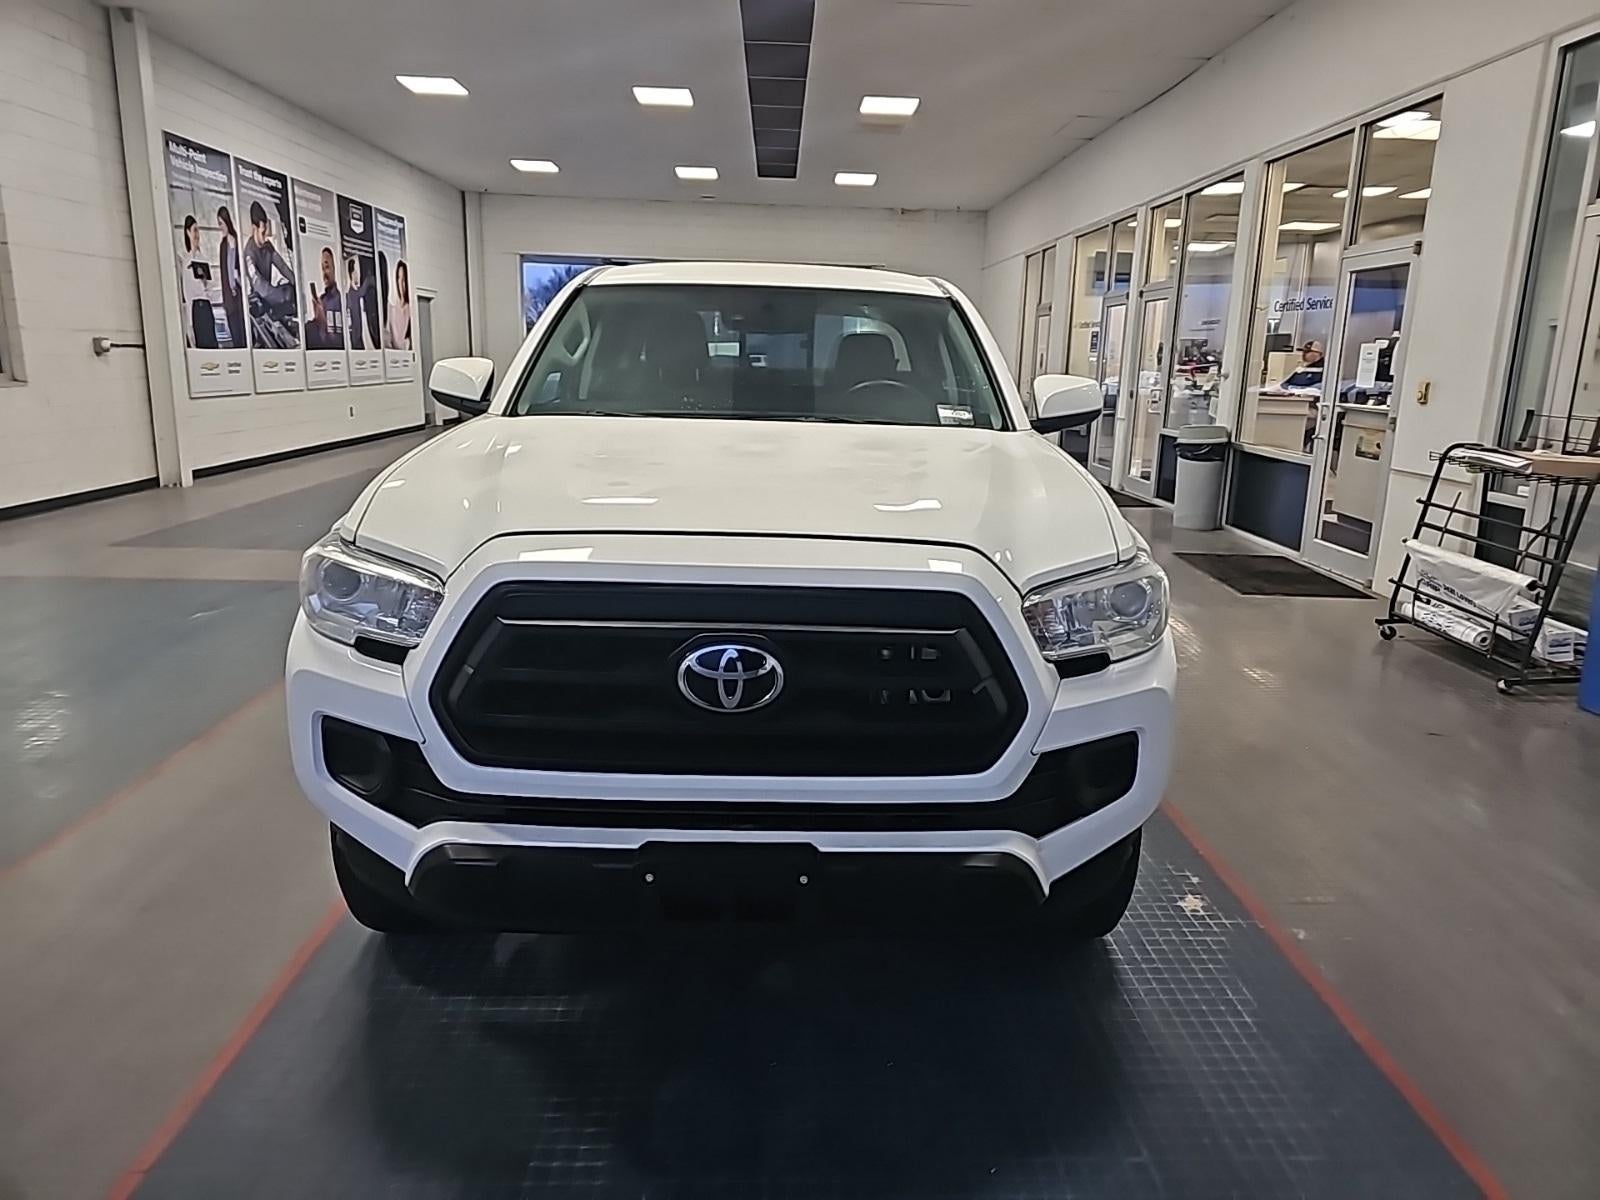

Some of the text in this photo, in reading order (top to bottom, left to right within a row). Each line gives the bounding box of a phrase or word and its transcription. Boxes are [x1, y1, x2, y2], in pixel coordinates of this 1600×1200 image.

[169, 154, 228, 183] Vehicle Inspection
[1274, 297, 1305, 312] Certified
